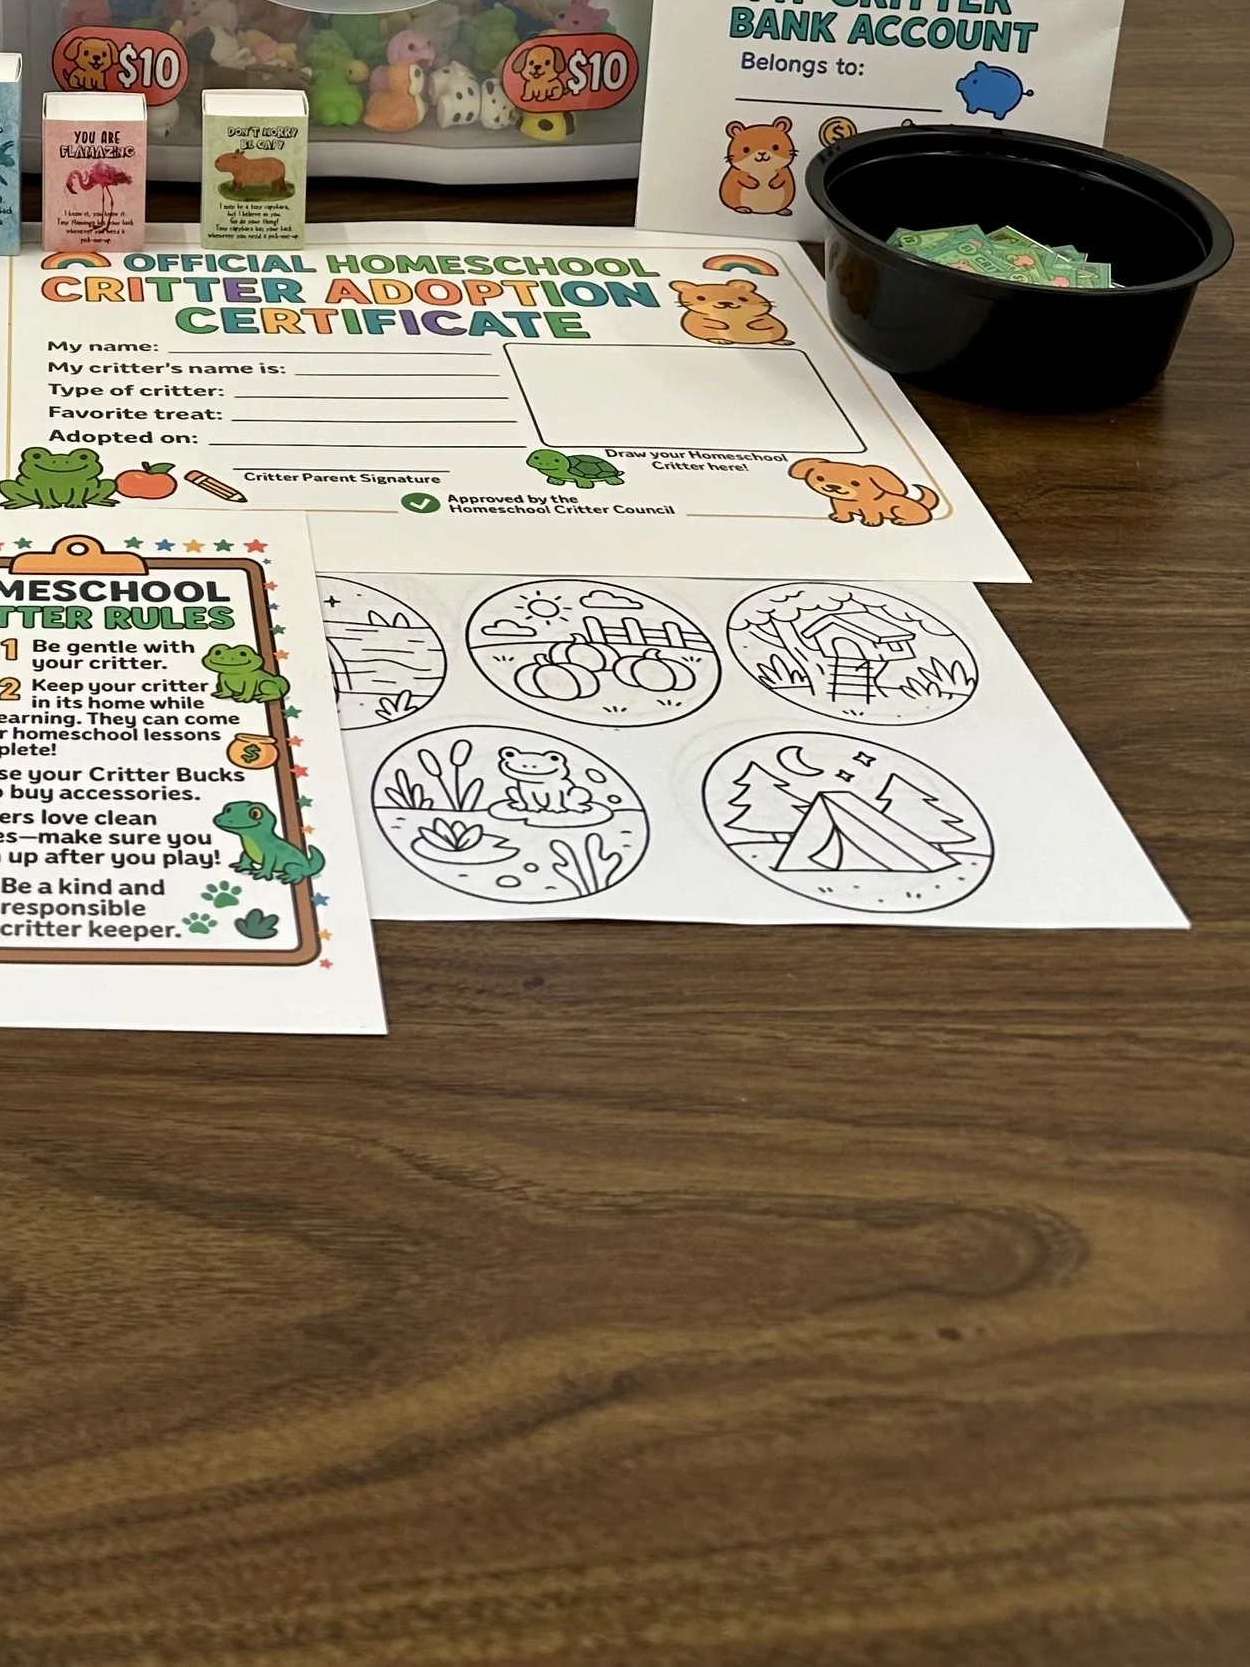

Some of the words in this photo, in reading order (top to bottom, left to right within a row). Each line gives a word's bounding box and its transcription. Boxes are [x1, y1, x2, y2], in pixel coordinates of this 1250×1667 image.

[729, 6, 837, 43] BANK
[847, 14, 1038, 53] ACCOUNT
[118, 48, 179, 90] $10
[567, 48, 627, 93] $10
[740, 52, 828, 78] Belongs
[836, 56, 865, 76] to:
[74, 131, 95, 144] YOU
[101, 131, 120, 144] ARE
[123, 253, 316, 273] OFFICIAL
[327, 254, 659, 278] HOMESCHOOL
[41, 275, 304, 304] CRITTER
[325, 278, 661, 308] ADOPTION
[174, 307, 590, 338] CERTIFICATE
[47, 341, 82, 354] My
[88, 342, 158, 353] name:
[47, 362, 83, 375] My
[90, 362, 182, 374] critter's
[188, 364, 254, 374] name
[259, 362, 286, 374] is:
[48, 384, 103, 399] Type
[109, 384, 134, 397] of
[140, 384, 225, 397] critter:
[49, 406, 147, 420] Favorite
[153, 407, 223, 421] treat:
[49, 429, 153, 446] Adopted
[160, 431, 198, 444] on:
[605, 449, 647, 458] Draw
[651, 452, 685, 462] your
[688, 451, 788, 462] Homeschool
[652, 462, 703, 471] Critter
[706, 462, 748, 472] here!
[244, 472, 300, 483] Critter
[302, 473, 358, 484] Parent
[361, 473, 441, 485] Signature
[448, 495, 525, 505] Approved
[529, 495, 547, 505] by
[551, 495, 578, 504] the
[449, 505, 551, 515] Homeschool
[555, 505, 609, 515] Critter
[613, 505, 675, 515] Council
[105, 606, 235, 630] RULES
[0, 639, 18, 660] 1
[32, 639, 60, 655] Be
[65, 639, 138, 658] gentle
[144, 640, 195, 655] with
[32, 658, 84, 672] your
[90, 656, 168, 670] critter.
[32, 679, 82, 697] Keep
[85, 680, 136, 696] your
[141, 679, 208, 693] critter
[32, 695, 50, 710] in
[56, 695, 83, 710] its
[88, 696, 145, 710] home
[150, 695, 204, 710] while
[28, 769, 84, 786] your
[88, 766, 172, 783] Critter
[176, 767, 245, 783] Bucks
[10, 784, 52, 803] buy
[58, 786, 201, 802] accessories.
[41, 809, 89, 826] love
[95, 810, 156, 826] clean
[1, 878, 32, 896] Be
[38, 883, 51, 896] a
[58, 879, 112, 896] kind
[119, 880, 165, 896] and
[1, 899, 146, 918] responsible
[0, 920, 82, 938] critter
[88, 922, 182, 940] keeper.
